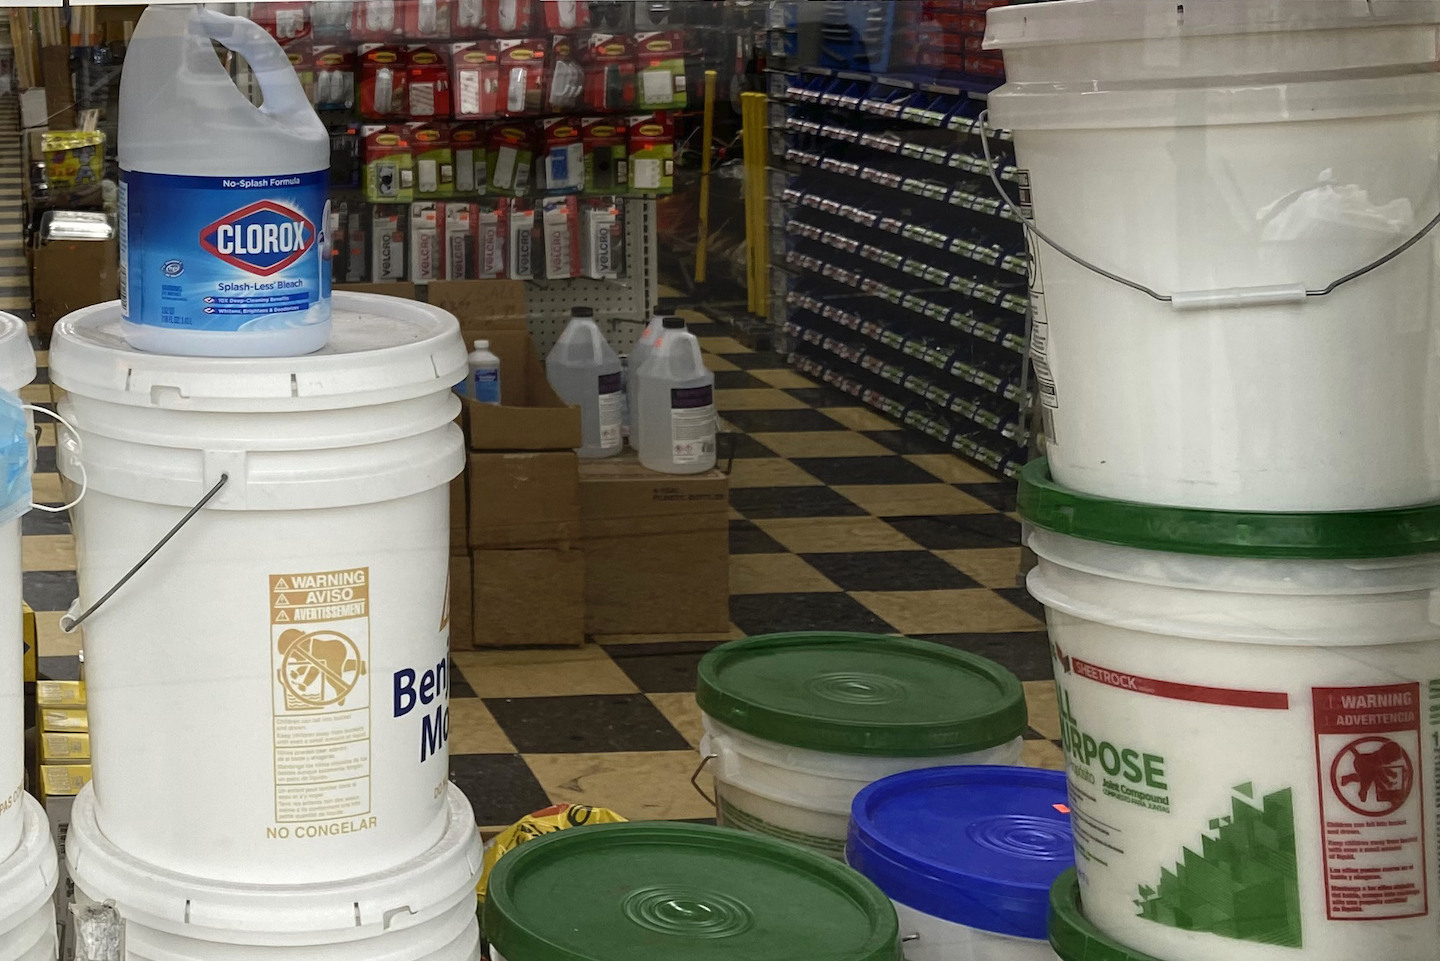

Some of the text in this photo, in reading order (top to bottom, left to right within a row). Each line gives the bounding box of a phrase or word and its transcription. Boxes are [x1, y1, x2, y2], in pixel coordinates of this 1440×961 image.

[223, 177, 300, 189] No-Splash Formula
[217, 220, 305, 255] CLOROX
[218, 279, 303, 292] Splash-Less Bleach
[291, 570, 365, 588] WARNING
[306, 587, 353, 604] AVISO
[294, 602, 365, 621] AVERTISSEMENT
[1075, 661, 1137, 690] SHEETROCK
[1341, 692, 1412, 709] WARNING
[1336, 711, 1414, 726] ADVERTENCIA
[1102, 778, 1169, 805] Joint Compound
[0, 800, 13, 818] PAS
[267, 816, 377, 839] NO CONGELAR
